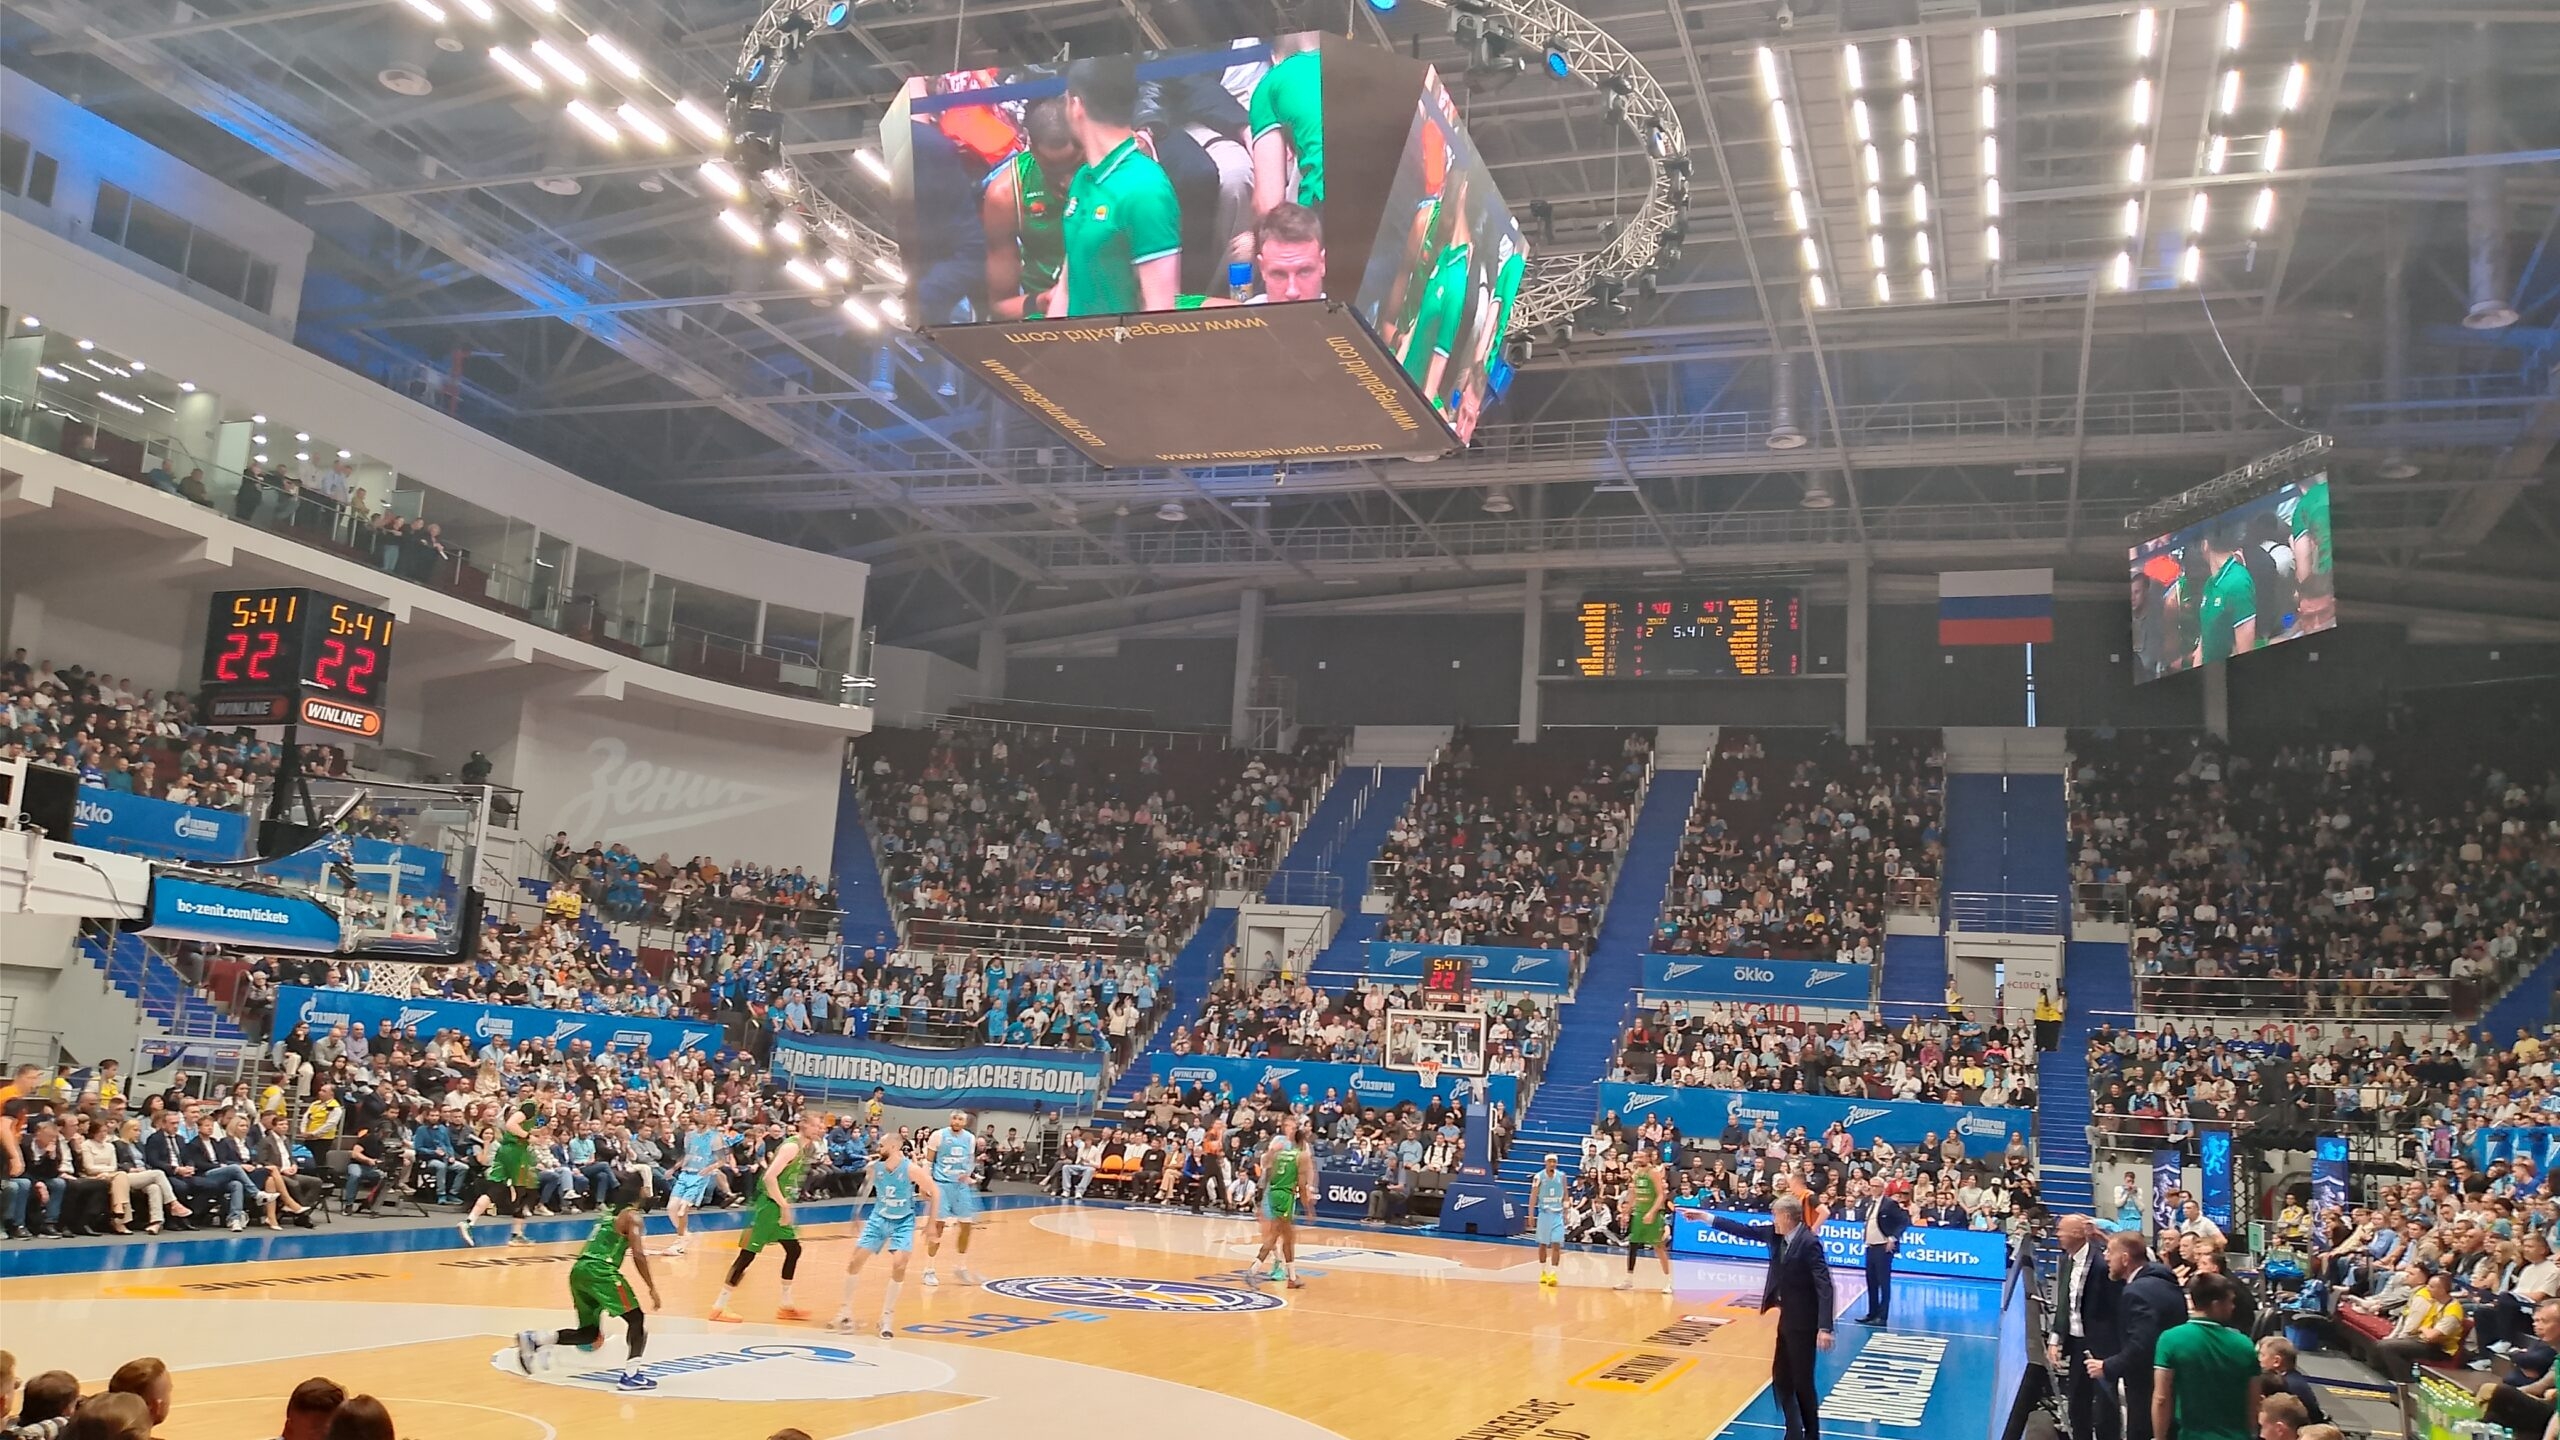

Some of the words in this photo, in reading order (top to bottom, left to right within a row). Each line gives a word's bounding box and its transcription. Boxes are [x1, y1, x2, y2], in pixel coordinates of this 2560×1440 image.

[232, 596, 297, 627] 5:41
[329, 604, 392, 646] 5:41
[216, 632, 280, 680] 22
[315, 639, 376, 694] 22
[213, 701, 272, 716] WINLINE
[307, 702, 364, 728] WINLINE
[176, 898, 289, 925] bc-zenit.com/tickets
[1430, 971, 1456, 989] 22
[824, 1056, 947, 1090] ПИТЕРСКОГО
[952, 1064, 1085, 1095] БАСКЕТБОЛА
[1906, 1248, 1980, 1265] «ЗЕНИТ»
[182, 1271, 389, 1293] WINLINE
